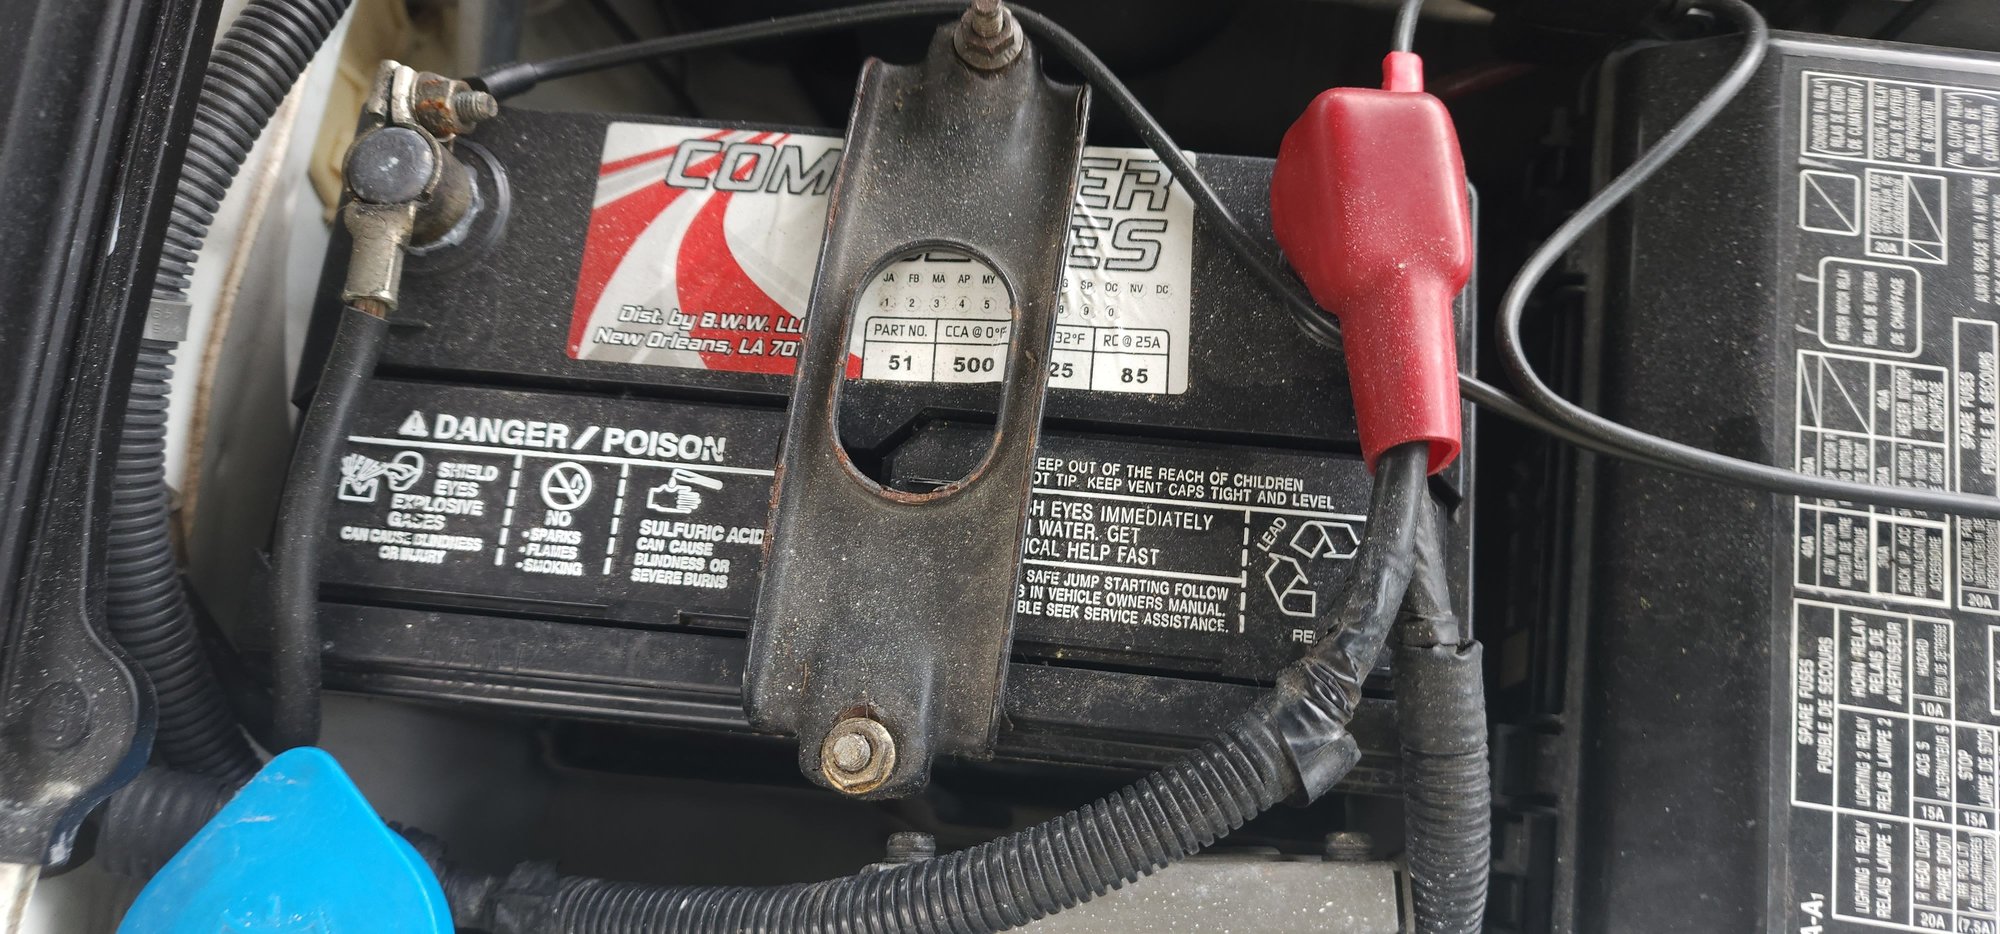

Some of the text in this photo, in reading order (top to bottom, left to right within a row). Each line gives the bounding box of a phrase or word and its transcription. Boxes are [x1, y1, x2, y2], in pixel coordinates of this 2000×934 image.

[1874, 85, 1888, 108] RELAY
[1890, 89, 1904, 157] RELAIS DE MOTEUR
[1965, 124, 1979, 154] RELAIS
[883, 273, 1169, 294] JA FB MA AP MY SP OC NV DC
[618, 305, 664, 325] Dist.
[669, 310, 697, 329] by
[700, 312, 769, 333] B.W.W.
[909, 299, 915, 308] 2
[934, 299, 940, 308] 3
[959, 299, 965, 308] 4
[984, 299, 990, 309] 5
[1083, 305, 1089, 316] 9
[593, 327, 764, 356] New Orleans, LA
[874, 323, 904, 336] PART
[906, 324, 927, 338] NO.
[946, 325, 968, 338] CCA
[972, 326, 983, 338] @
[1103, 336, 1119, 348] RC
[1122, 337, 1132, 348] @
[1135, 336, 1161, 349] 25A
[888, 355, 1148, 384] 51 500 25 85
[433, 413, 726, 462] DANGER POISON
[437, 461, 499, 482] SHIELD
[1038, 457, 1303, 492] EEP OUT OF THE REACH OF CHILDREN
[433, 479, 480, 497] EYES
[1034, 472, 1049, 485] OT
[1087, 477, 1122, 491] KEEP
[1128, 480, 1164, 494] VENT
[1168, 484, 1205, 498] CAPS
[1211, 486, 1253, 503] TIGHT
[1257, 490, 1286, 505] AND
[1292, 493, 1335, 510] LEVEL
[391, 493, 484, 516] EXPLOSIVE
[544, 510, 572, 527] NO
[1051, 501, 1093, 521] EYES
[1100, 504, 1214, 532] IMMEDIATELY
[340, 526, 369, 542] CAN
[387, 511, 446, 531] GASES
[639, 519, 766, 545] SULFURIC ACID
[1039, 519, 1099, 541] WATER.
[1107, 525, 1140, 544] GET
[1257, 515, 1287, 552] LEAD
[378, 546, 399, 560] OR
[636, 537, 714, 556] CAN CAUSE
[1025, 538, 1160, 566] ICAL HELP FAST
[633, 552, 730, 574] BLINDNESS OR
[630, 568, 728, 589] SEVERE BURNS
[1026, 569, 1229, 601] SAFE JUMP STARTING FOLLOW
[1030, 587, 1043, 600] IN
[1048, 587, 1102, 605] VEHICLE
[1106, 594, 1164, 611] OWNERS
[1168, 600, 1226, 617] MANUAL.
[1046, 603, 1229, 634] SEEK SERVICE ASSISTANCE.
[1851, 617, 1867, 698] HORN RELAY
[1869, 628, 1884, 695] RELAIS DE
[1887, 622, 1902, 705] AVERTISSEUR
[1798, 659, 1814, 745] SPARE FUSES
[1817, 637, 1833, 774] FUSIBLE DE SECOURS
[1920, 701, 1944, 718] 10A
[1855, 716, 1871, 807] LIGHTING 2 RELAY
[1876, 718, 1892, 812] RELAIS LAMPE 2
[1958, 749, 1974, 781] STOP
[1920, 805, 1946, 822] 15A
[1963, 810, 1988, 828] 15A
[1854, 820, 1870, 855] RELAY
[1915, 827, 1930, 859] LIGHT
[1876, 833, 1892, 873] LAMPE
[1915, 860, 1930, 890] HEAD
[1936, 866, 1952, 902] PHARE
[1854, 867, 1870, 914] LIGHTING
[1876, 877, 1892, 919] RELAIS
[1920, 912, 1946, 930] 20A
